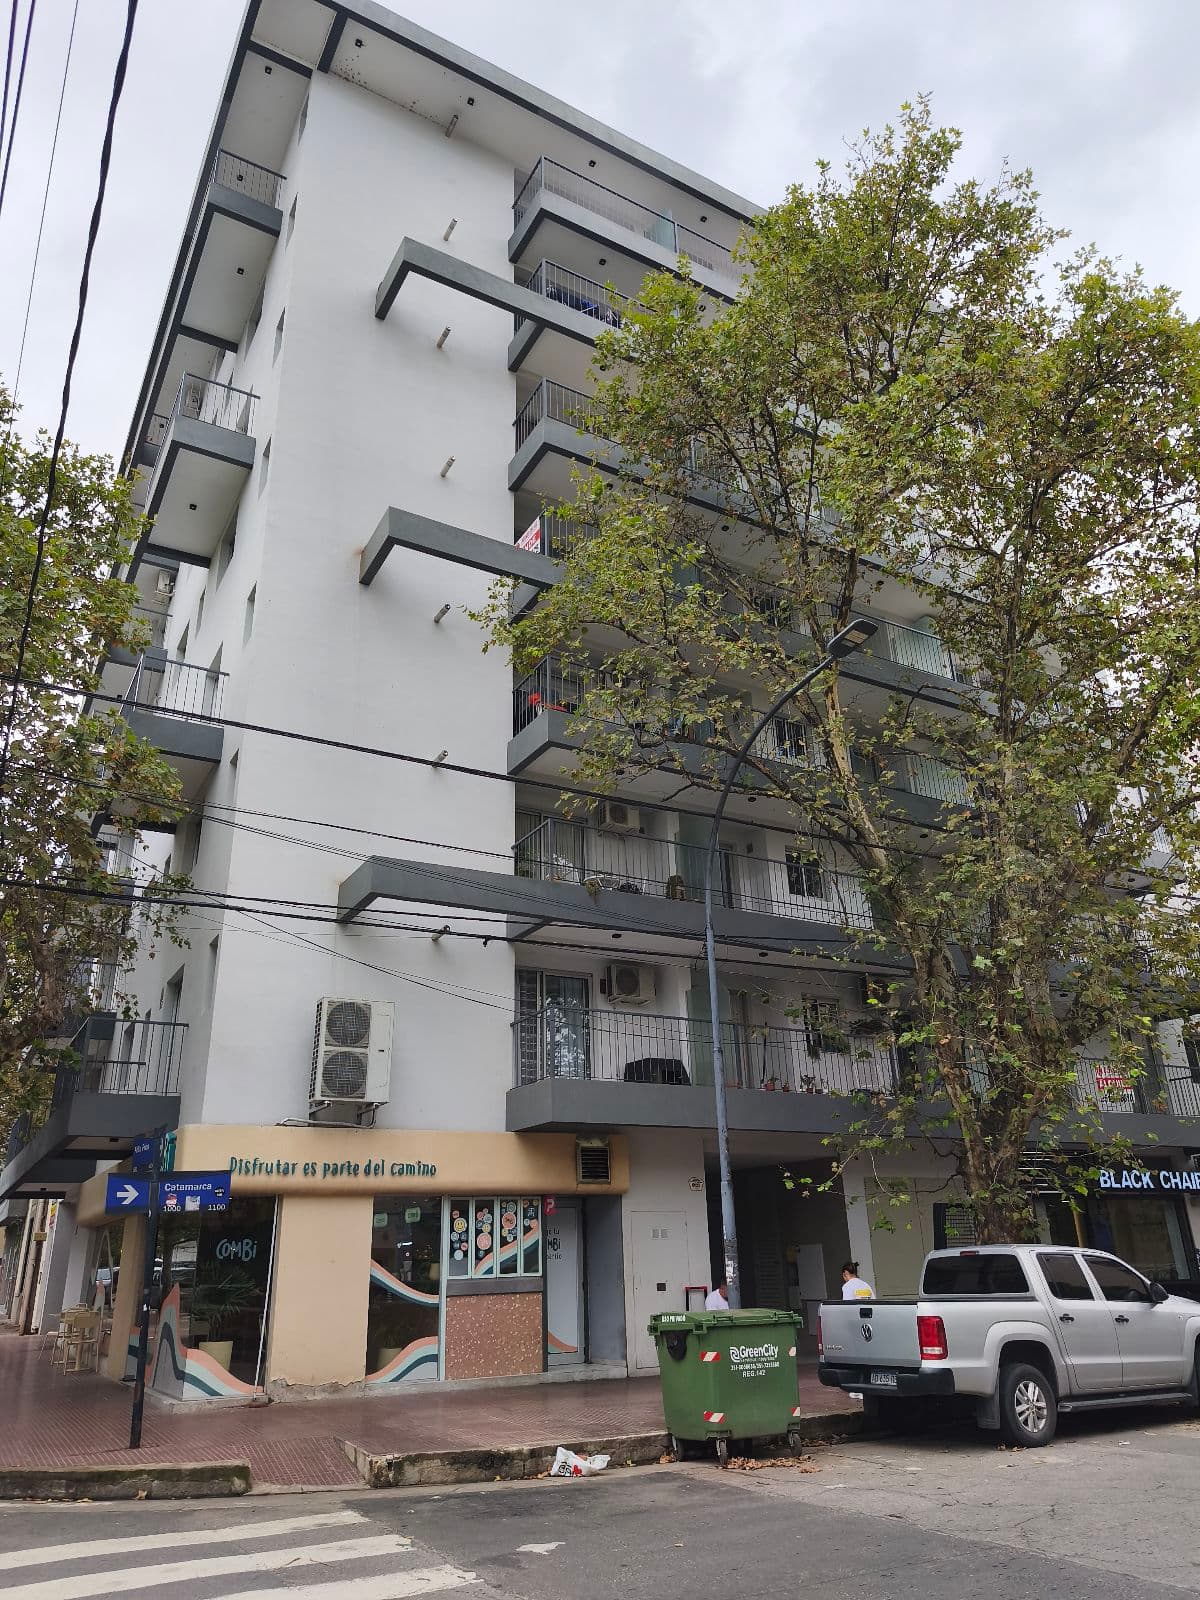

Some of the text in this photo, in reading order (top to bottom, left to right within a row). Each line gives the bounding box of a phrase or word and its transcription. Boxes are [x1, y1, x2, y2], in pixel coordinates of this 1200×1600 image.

[229, 1156, 437, 1180] Disfrutar es parte del camino
[1100, 1169, 1155, 1189] BLACK
[164, 1183, 212, 1191] Catamarca
[207, 1203, 226, 1211] 1100
[740, 1344, 778, 1358] GreenCity
